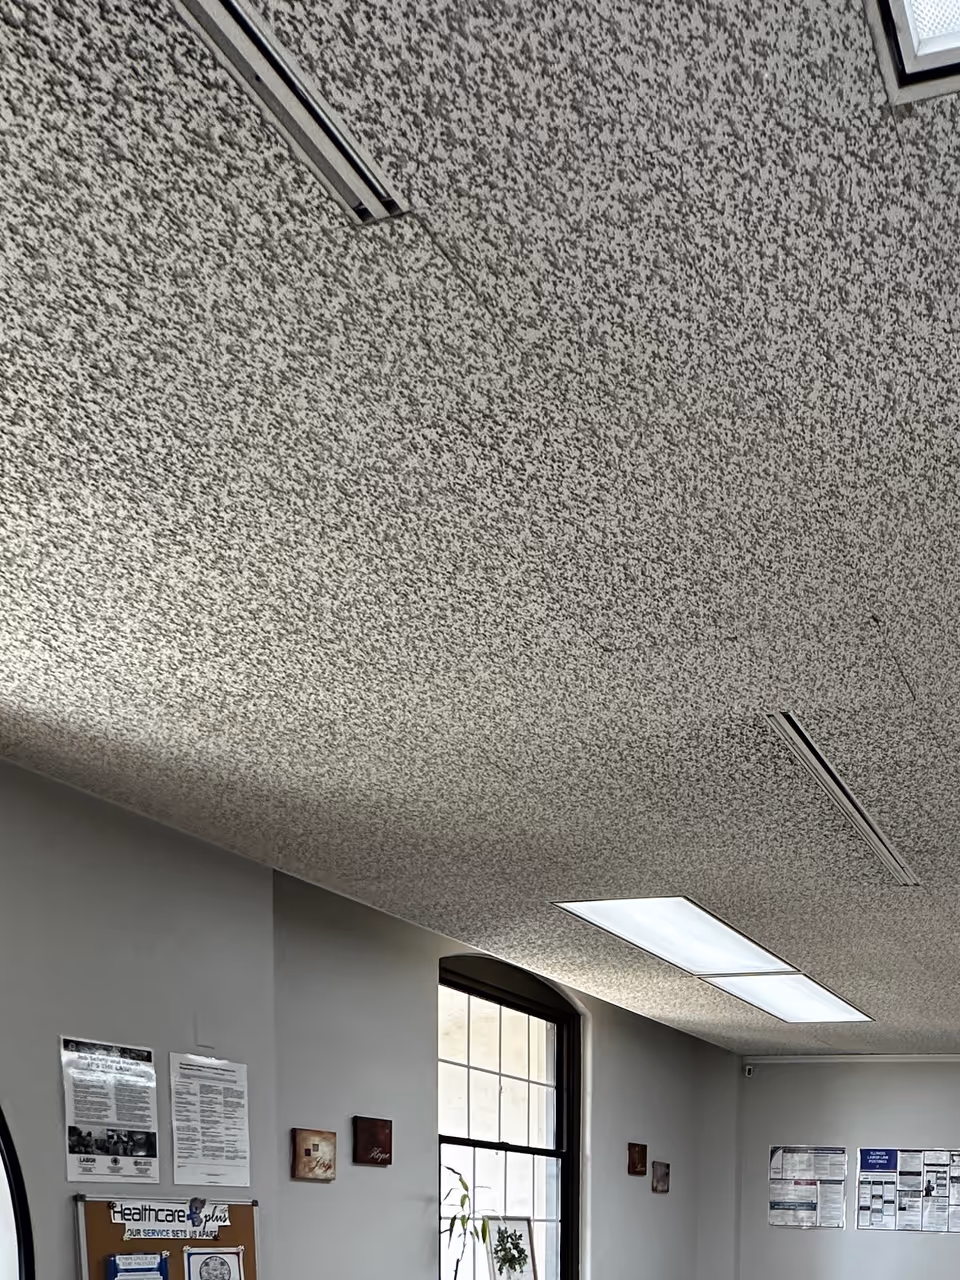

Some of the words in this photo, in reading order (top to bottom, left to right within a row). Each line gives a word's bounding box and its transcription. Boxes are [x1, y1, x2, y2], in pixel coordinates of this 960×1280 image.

[112, 1203, 186, 1223] Healthcare
[202, 1205, 229, 1232] plus
[126, 1228, 142, 1237] OUR
[142, 1228, 170, 1238] SERVICE
[171, 1229, 187, 1238] SETS
[189, 1230, 198, 1238] US
[198, 1230, 218, 1239] APART
